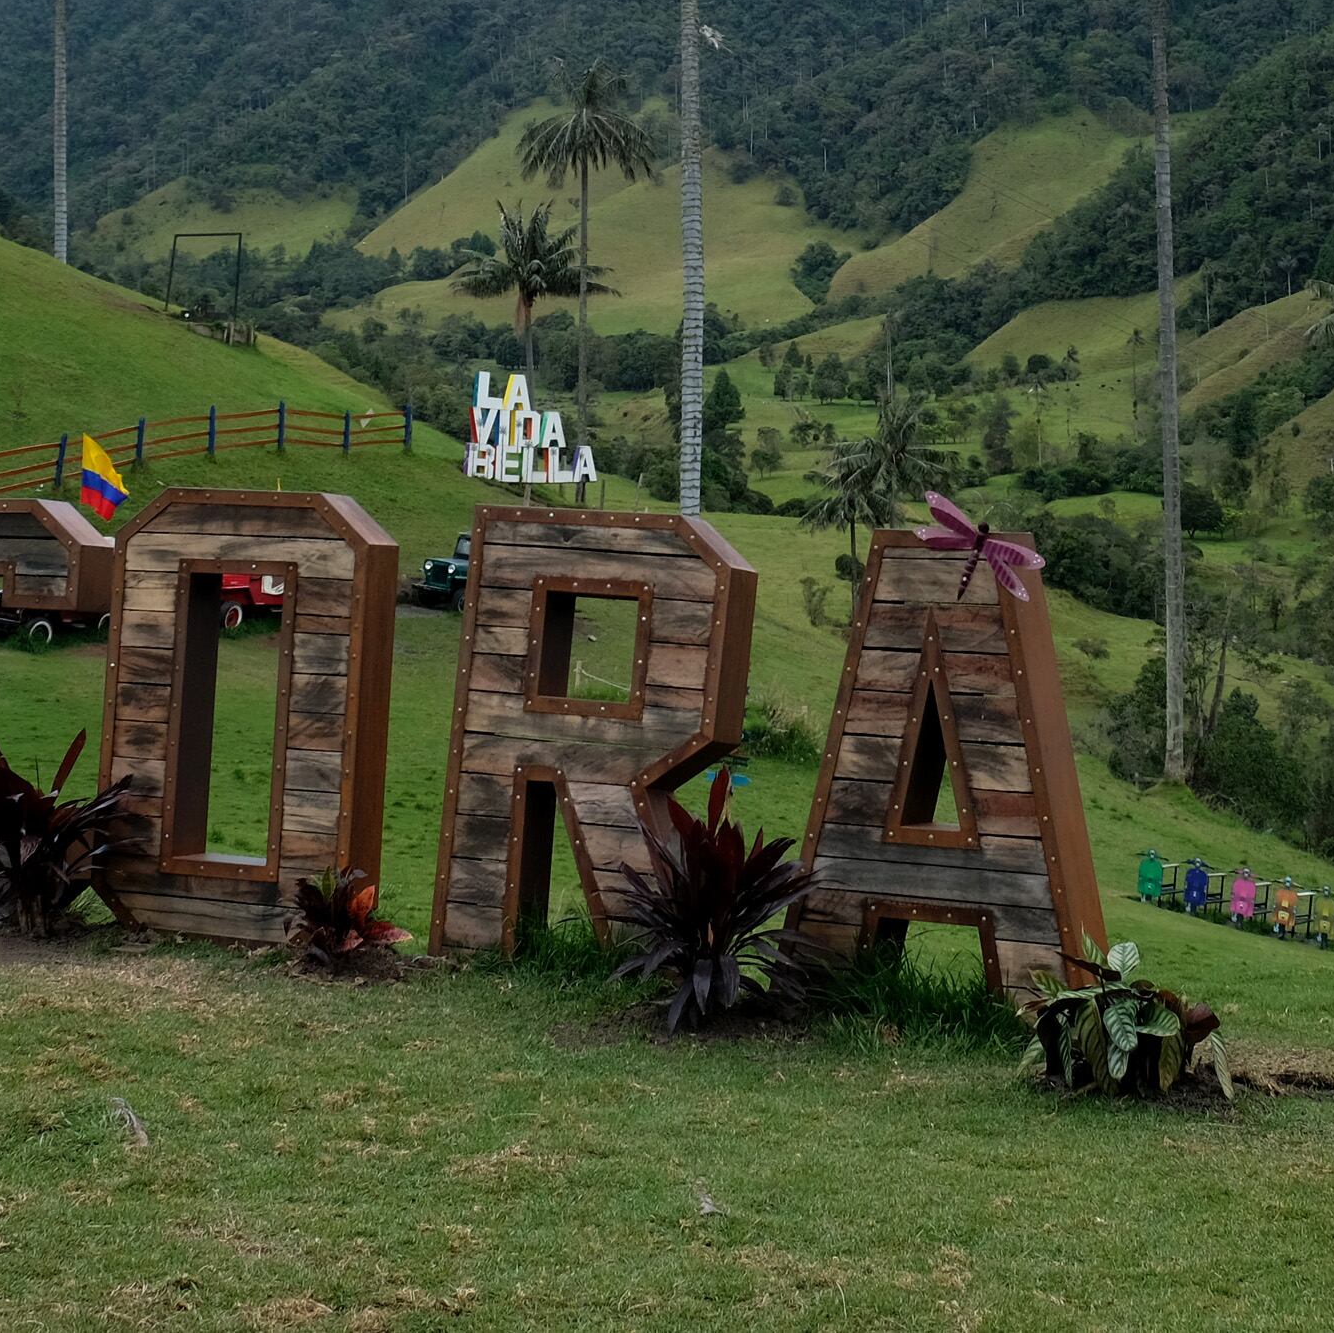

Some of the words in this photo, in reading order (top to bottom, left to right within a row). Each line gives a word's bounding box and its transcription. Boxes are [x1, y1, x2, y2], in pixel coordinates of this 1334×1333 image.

[473, 371, 531, 411] LA
[469, 407, 567, 449] VIDA
[463, 441, 598, 483] BELLA
